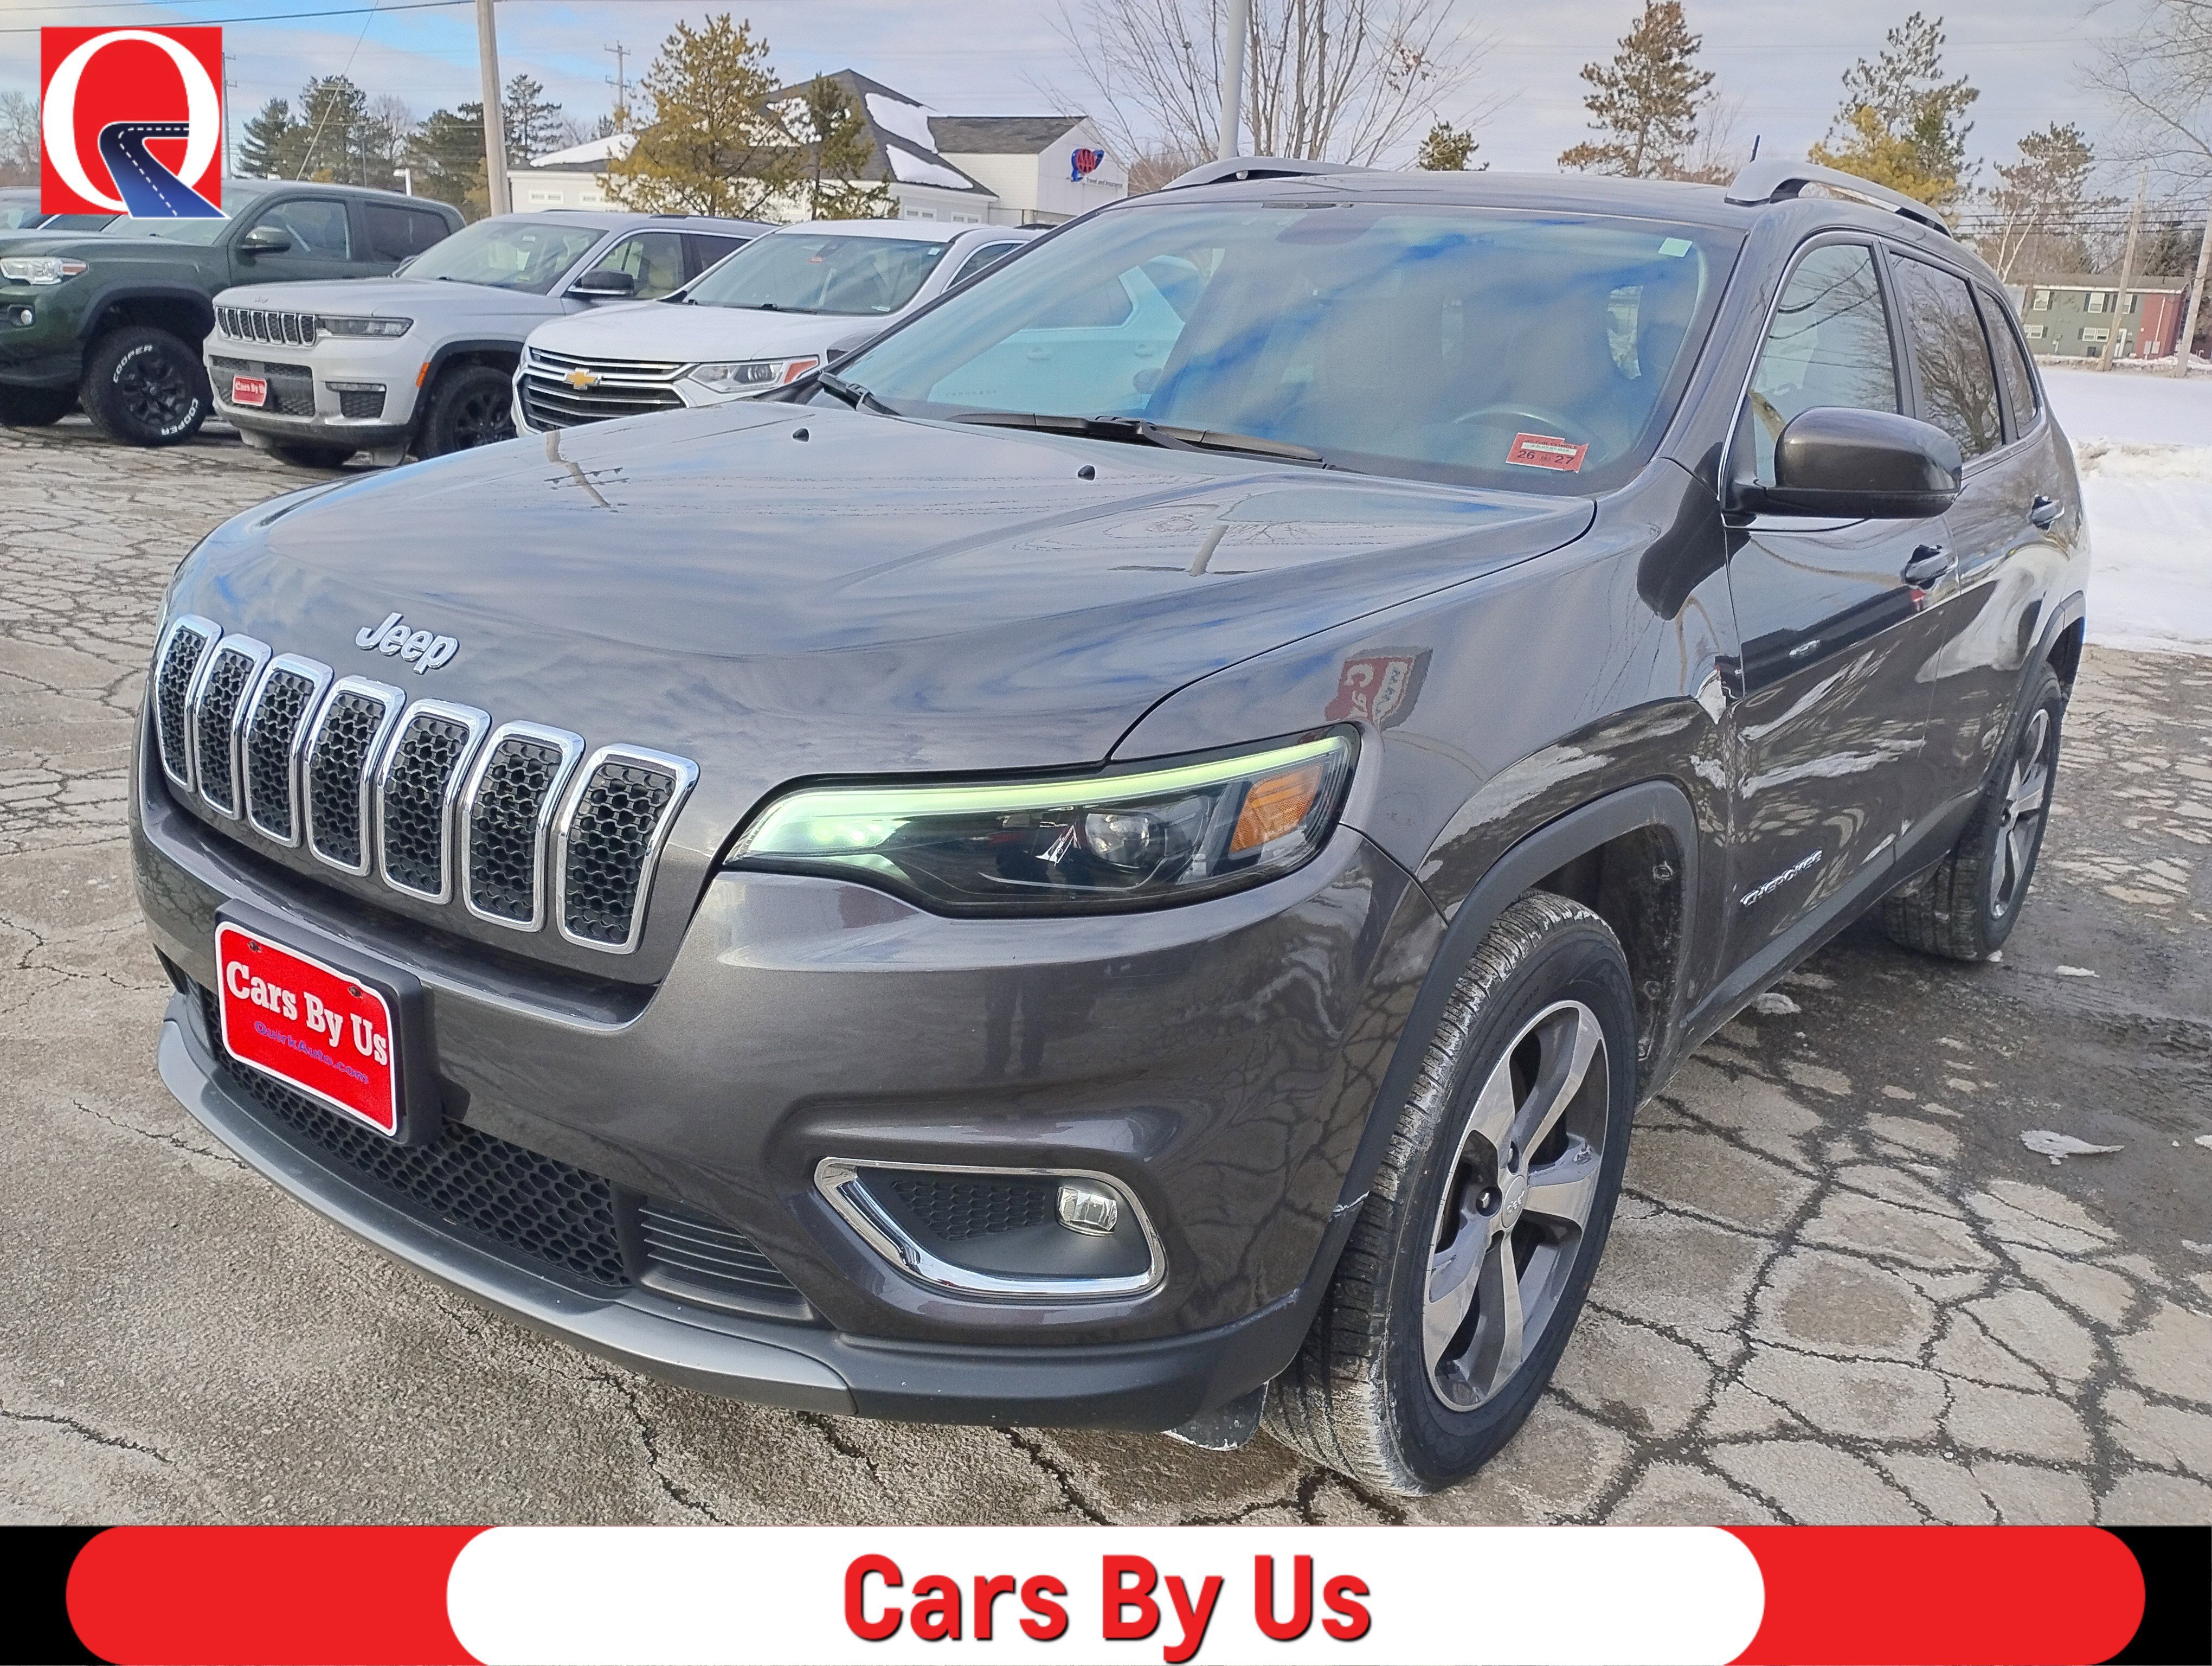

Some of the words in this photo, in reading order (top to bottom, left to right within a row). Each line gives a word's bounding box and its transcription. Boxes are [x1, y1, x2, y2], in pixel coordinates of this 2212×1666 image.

[113, 344, 153, 383] COOPER
[161, 398, 198, 435] COOPER
[1517, 450, 1535, 459] 26
[1554, 455, 1574, 465] 27
[355, 611, 460, 675] Jeep
[226, 960, 298, 1021] Cars
[303, 991, 343, 1048] By
[350, 1013, 388, 1066] Us
[254, 1021, 369, 1084] QuirkAuto.com
